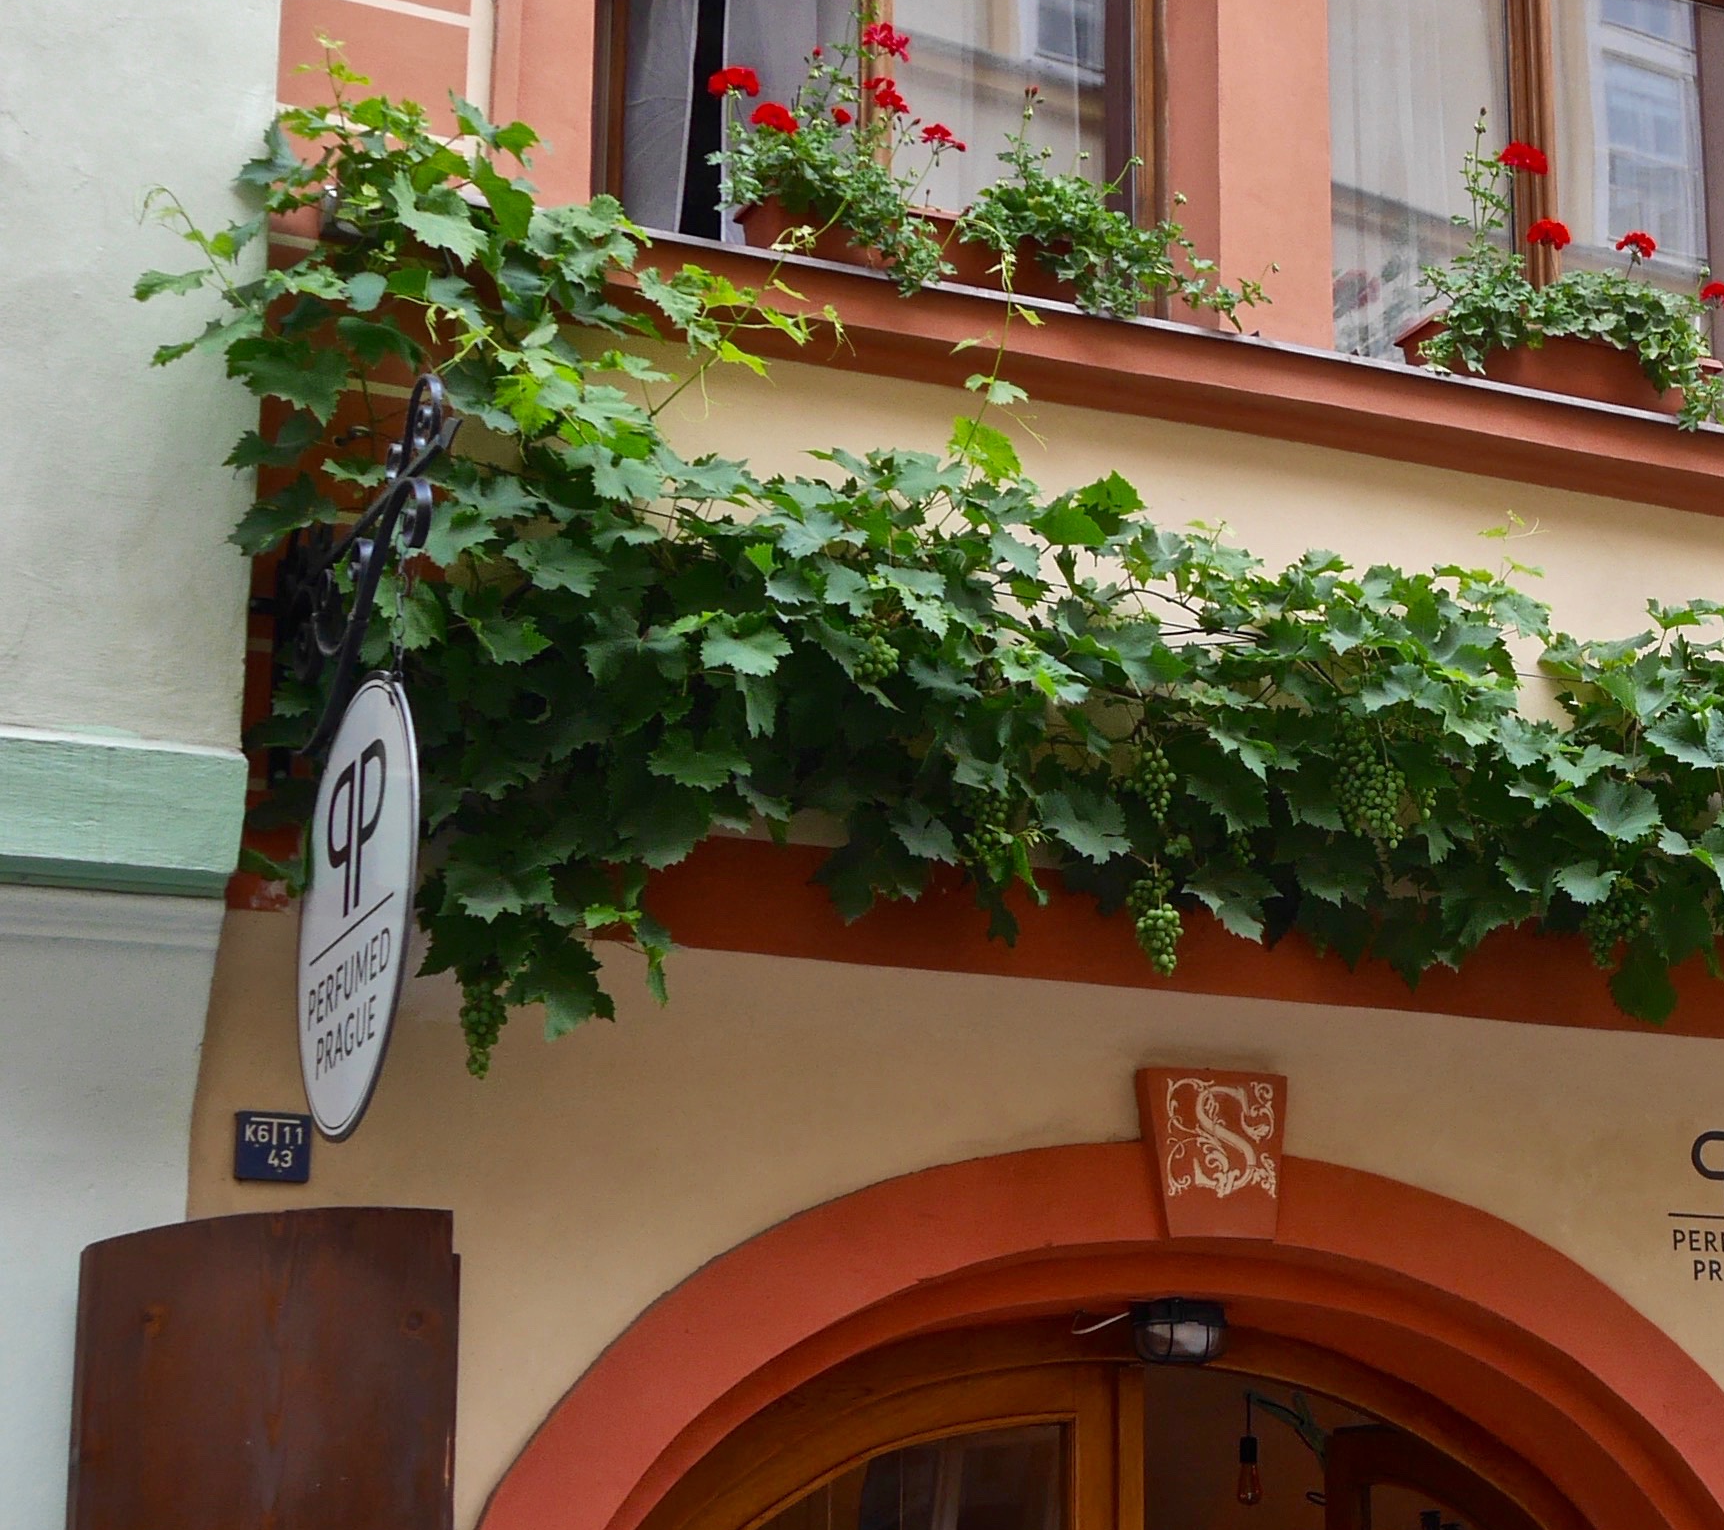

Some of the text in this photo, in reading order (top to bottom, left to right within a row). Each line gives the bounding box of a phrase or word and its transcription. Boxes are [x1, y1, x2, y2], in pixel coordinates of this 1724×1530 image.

[307, 927, 391, 1031] PERFUMED
[315, 995, 377, 1080] PRAGUE
[267, 1149, 292, 1168] 43
